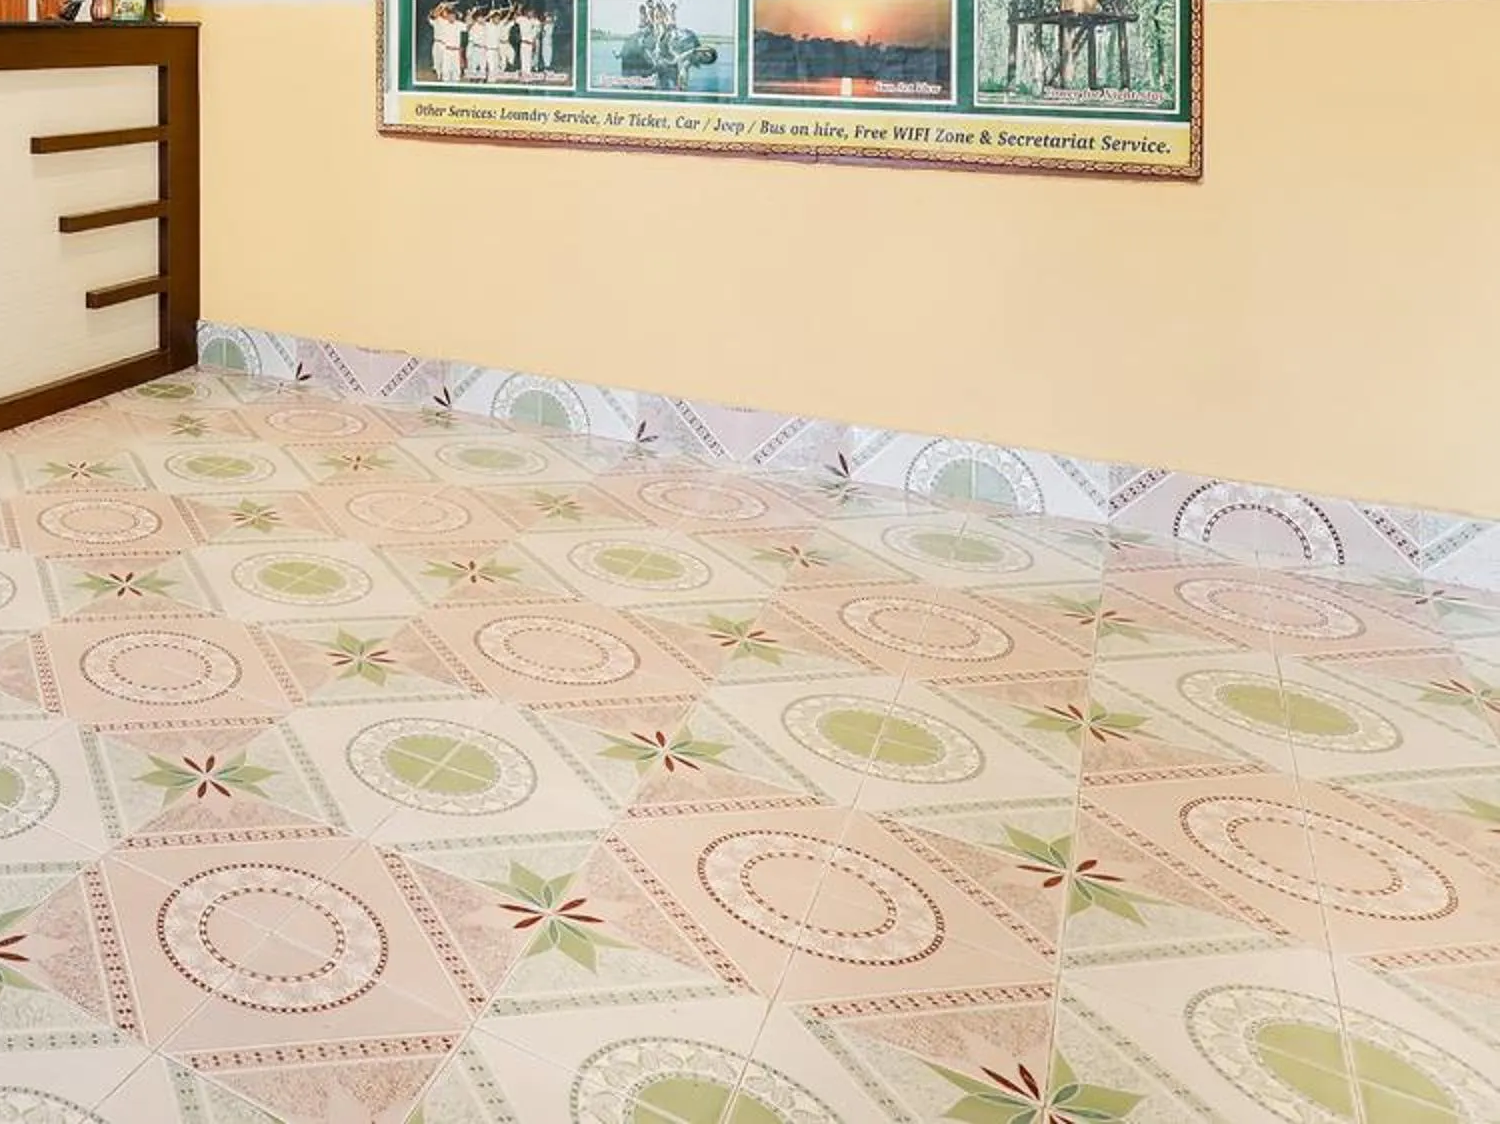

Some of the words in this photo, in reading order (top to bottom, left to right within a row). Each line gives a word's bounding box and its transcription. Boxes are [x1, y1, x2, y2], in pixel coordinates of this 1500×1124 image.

[415, 103, 446, 117] Other
[448, 105, 497, 120] Services:
[603, 111, 623, 126] Air
[628, 112, 670, 129] Ticket,
[675, 115, 700, 130] Car
[713, 117, 744, 136] Jeep
[760, 119, 786, 136] Bus
[790, 123, 809, 137] on
[813, 120, 849, 141] hire,
[854, 124, 888, 141] Free
[894, 126, 930, 143] WIFI
[935, 127, 975, 145] Zone
[979, 130, 993, 145] &
[998, 130, 1095, 151] Secretariat
[1101, 134, 1172, 155] Service.
